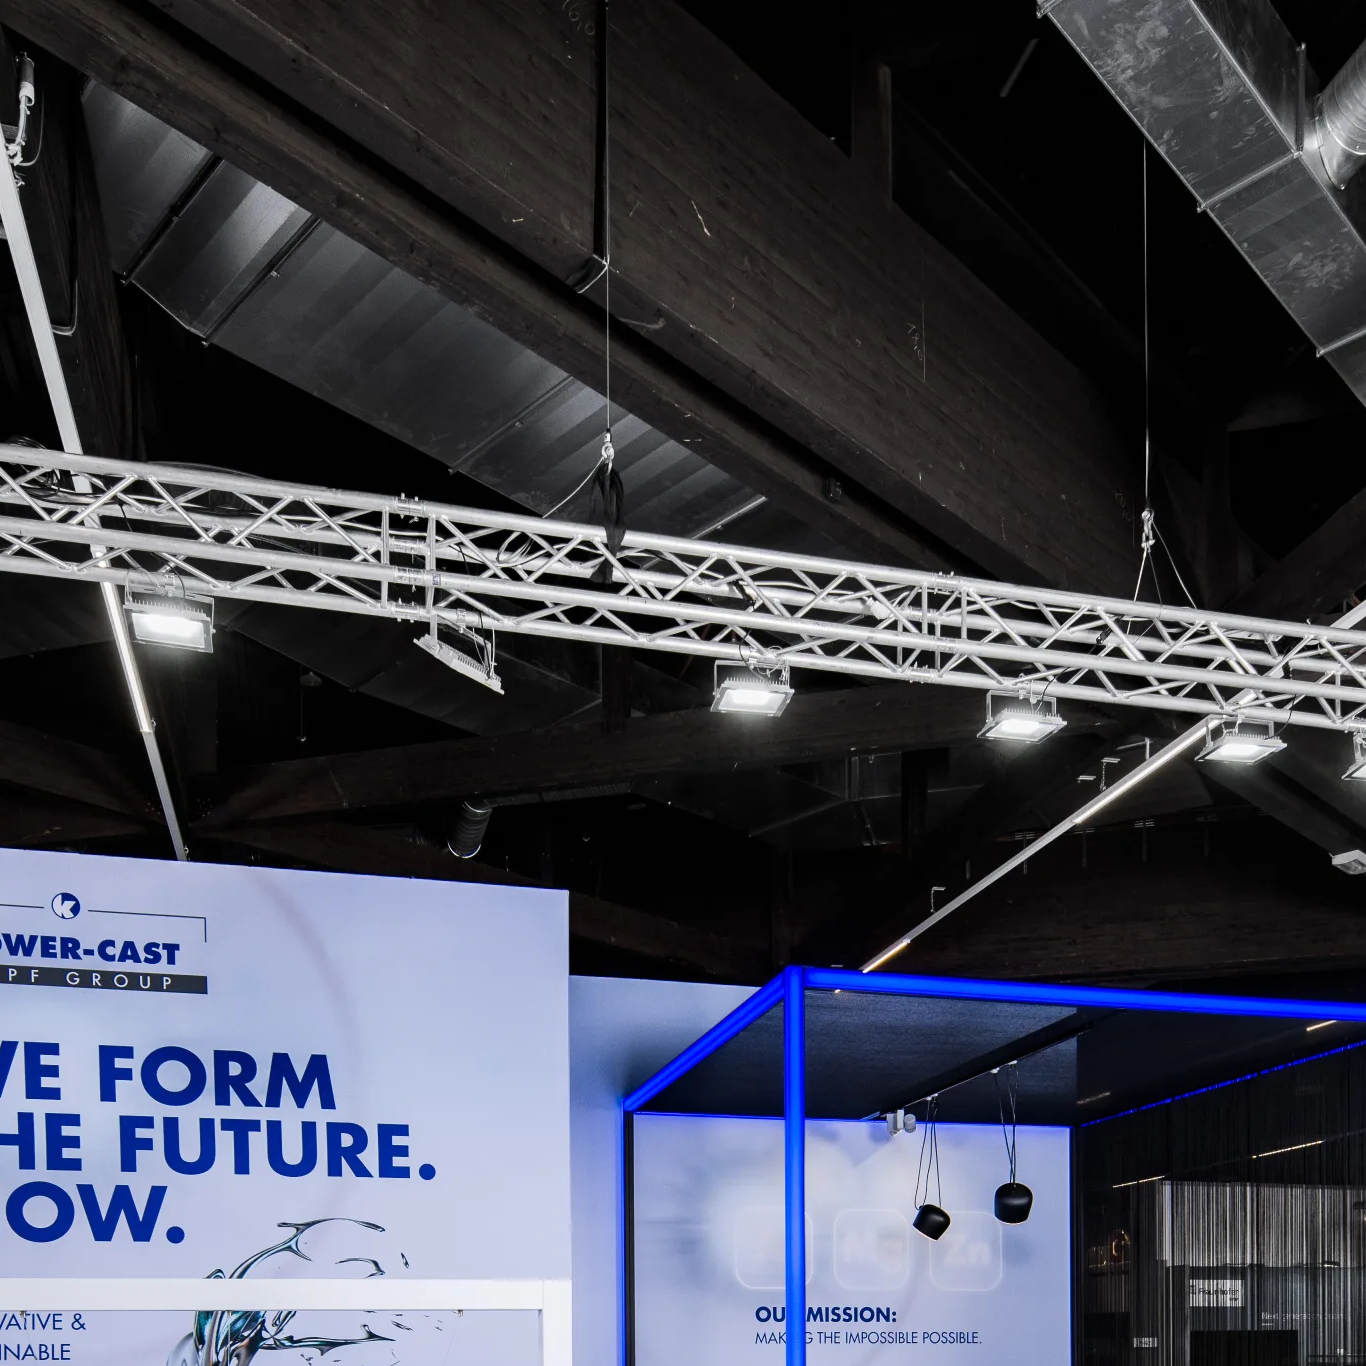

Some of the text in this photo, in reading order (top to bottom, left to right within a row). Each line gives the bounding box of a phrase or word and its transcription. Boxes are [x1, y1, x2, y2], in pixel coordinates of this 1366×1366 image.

[66, 971, 172, 990] GROUP
[98, 1044, 336, 1110] FORM
[119, 1115, 436, 1181] FUTURE.
[71, 1312, 87, 1331] &
[755, 1306, 897, 1323] OU MISSION:
[755, 1331, 983, 1345] MAKG THE IMPOSSIBLE POSSIBLE.
